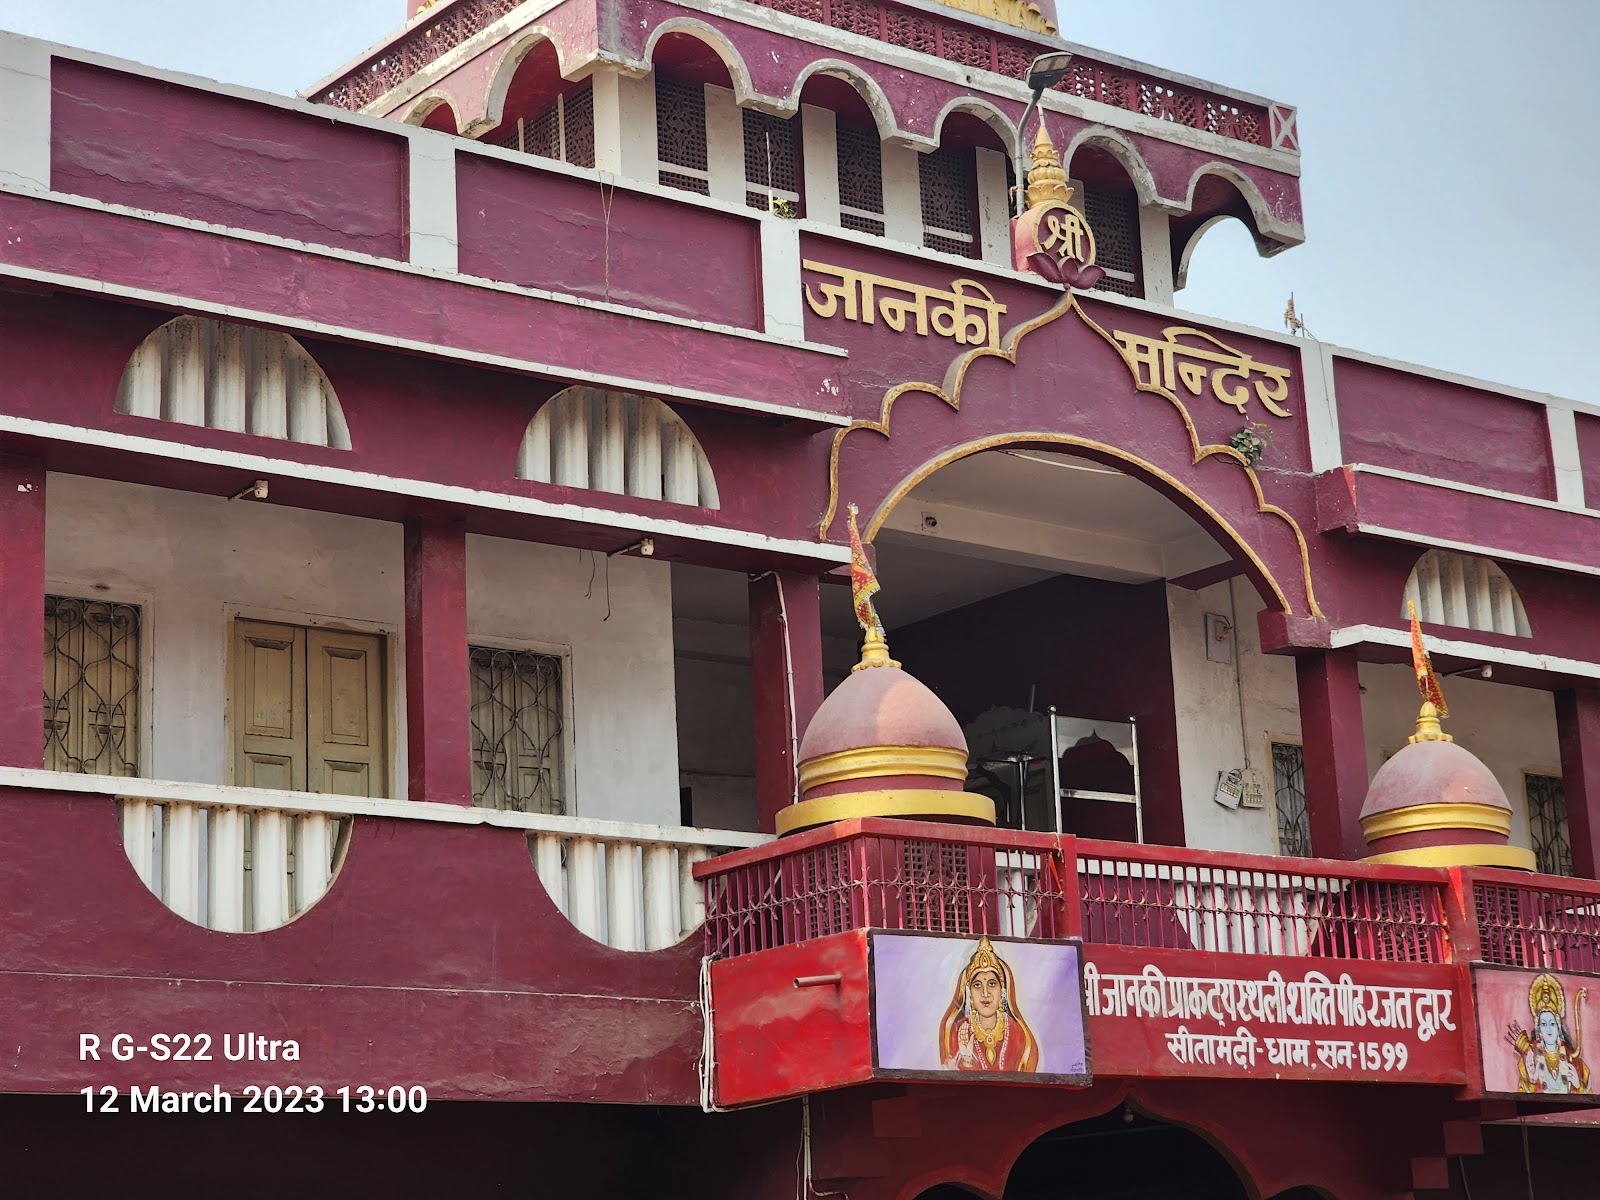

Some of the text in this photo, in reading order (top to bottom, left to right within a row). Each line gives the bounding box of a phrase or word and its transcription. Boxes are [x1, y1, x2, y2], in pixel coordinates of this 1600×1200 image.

[1040, 214, 1084, 262] श्री
[802, 258, 1293, 417] जानकी मन्दिर
[1101, 964, 1169, 1018] जानकी
[1286, 970, 1337, 1026] शक्ति
[1365, 985, 1414, 1029] रजत
[1413, 988, 1457, 1042] द्वार
